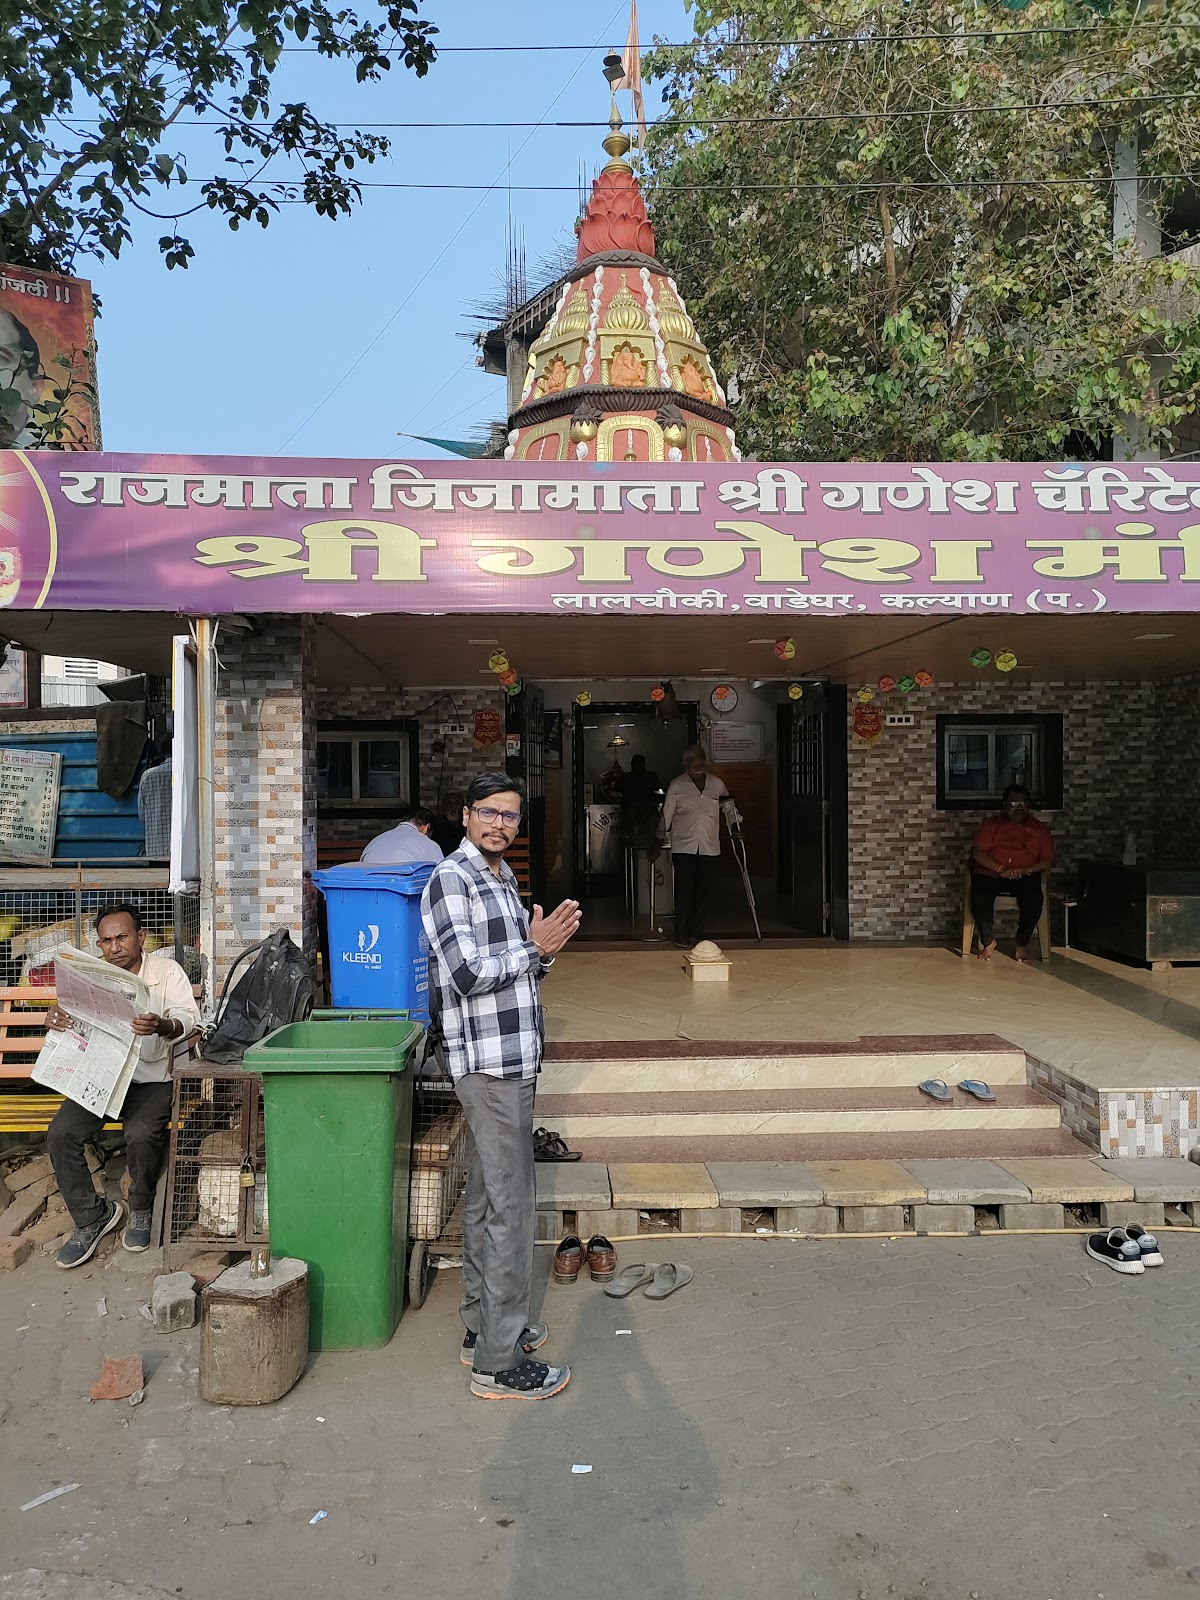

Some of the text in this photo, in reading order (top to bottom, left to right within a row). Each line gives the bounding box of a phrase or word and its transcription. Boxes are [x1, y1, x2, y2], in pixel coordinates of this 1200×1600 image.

[0, 270, 50, 298] ांजली
[60, 464, 1200, 514] राजमाता जिजामाता श्री गणेश चॅरिटे
[193, 519, 437, 581] श्री
[471, 521, 992, 582] गणेश
[881, 591, 1013, 610] कल्याण
[342, 951, 382, 964] KLEENO
